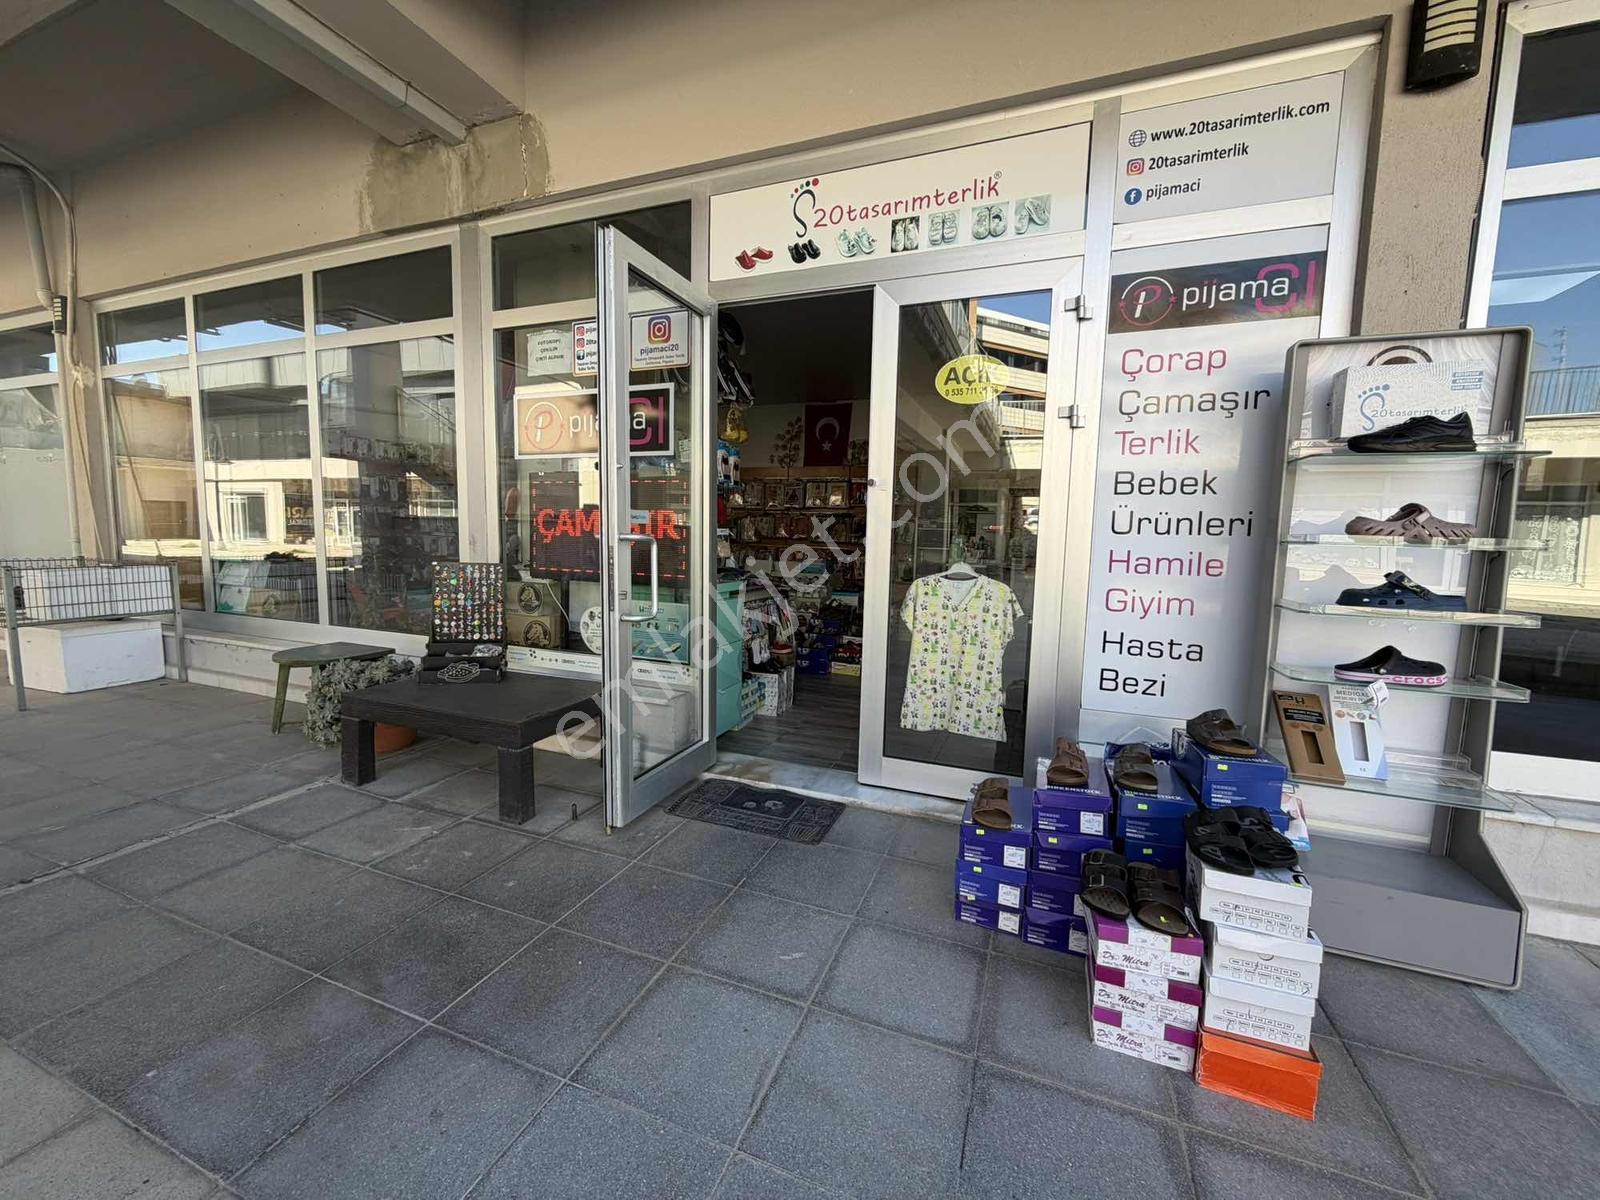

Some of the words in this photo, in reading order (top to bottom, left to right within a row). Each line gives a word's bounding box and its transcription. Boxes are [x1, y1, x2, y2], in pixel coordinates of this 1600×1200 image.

[1150, 101, 1330, 142] www.20tasarimterlik.com
[1148, 142, 1249, 170] 20tasarimterlik
[1145, 178, 1201, 201] pijamaci
[640, 343, 679, 356] pijamaci20
[1121, 348, 1227, 381] Çorap
[1118, 388, 1271, 423] Çamaşır
[1115, 428, 1200, 456] Terlik
[1114, 469, 1217, 496] Bebek
[1110, 504, 1253, 537] Ürünleri
[1107, 550, 1224, 577] Hamile
[1105, 587, 1195, 620] Giyim
[1101, 630, 1204, 662] Hasta
[1099, 667, 1166, 697] Bezi
[1392, 676, 1443, 685] crocs
[1122, 954, 1149, 968] Mitra
[1118, 993, 1145, 1009] Mitra
[1116, 1033, 1143, 1048] Mitra
